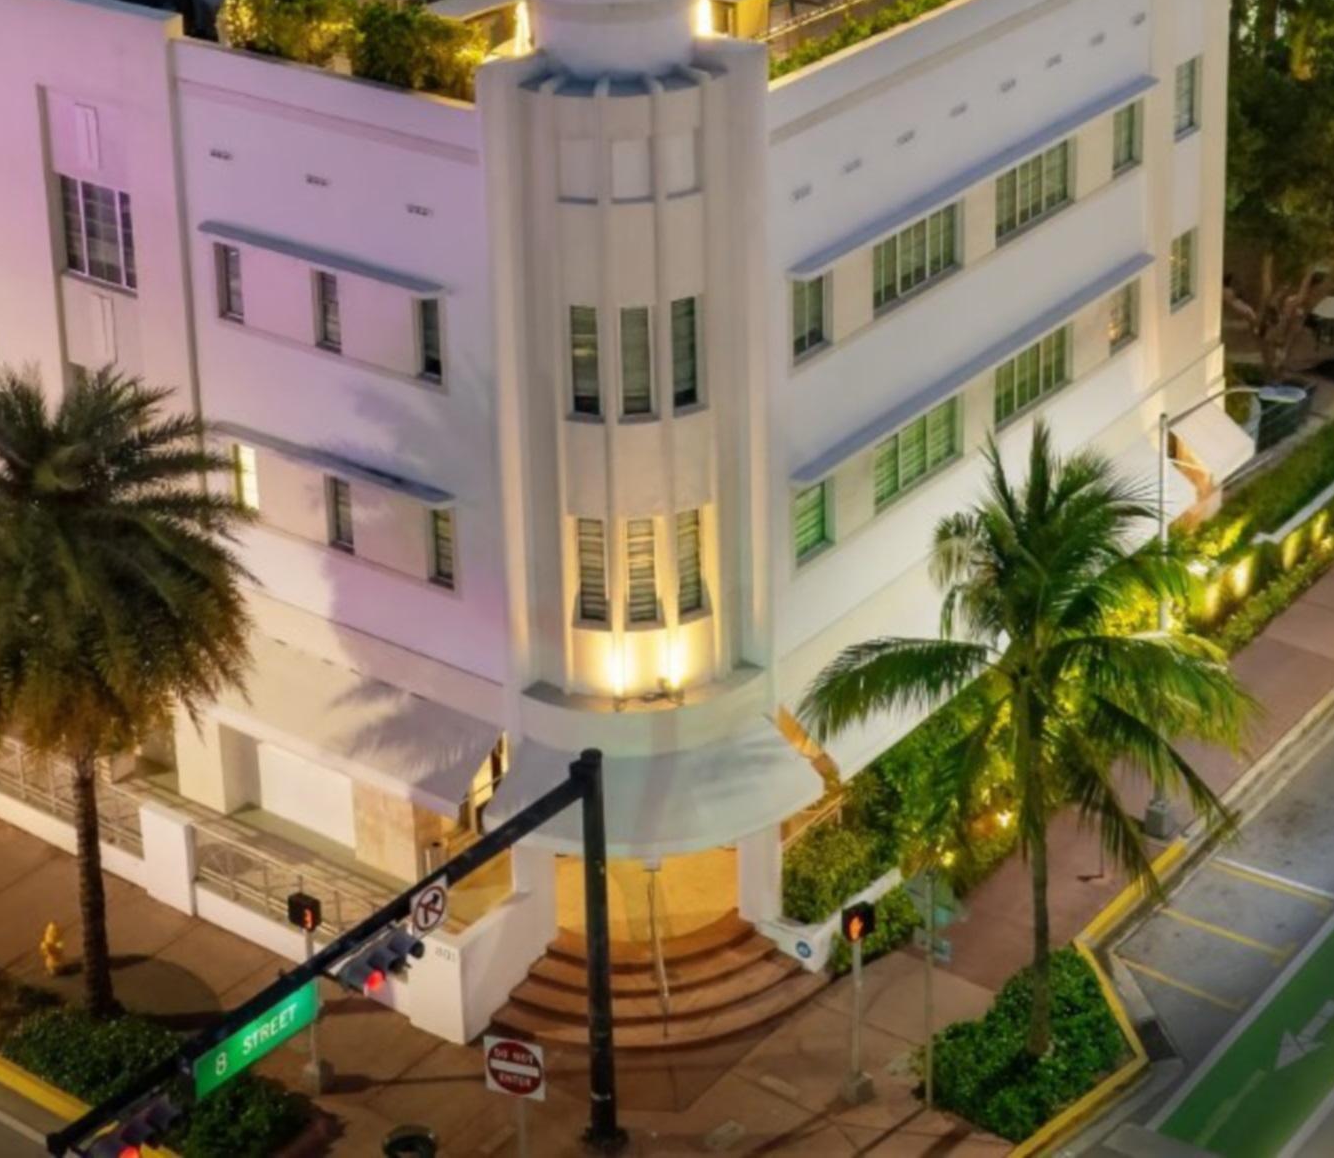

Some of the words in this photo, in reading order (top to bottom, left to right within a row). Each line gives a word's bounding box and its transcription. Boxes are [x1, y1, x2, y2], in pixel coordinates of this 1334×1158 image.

[215, 1052, 227, 1076] 8
[242, 1002, 298, 1055] STREET
[493, 1048, 508, 1059] DO
[512, 1051, 533, 1064] NOT
[498, 1073, 532, 1087] ENTER
